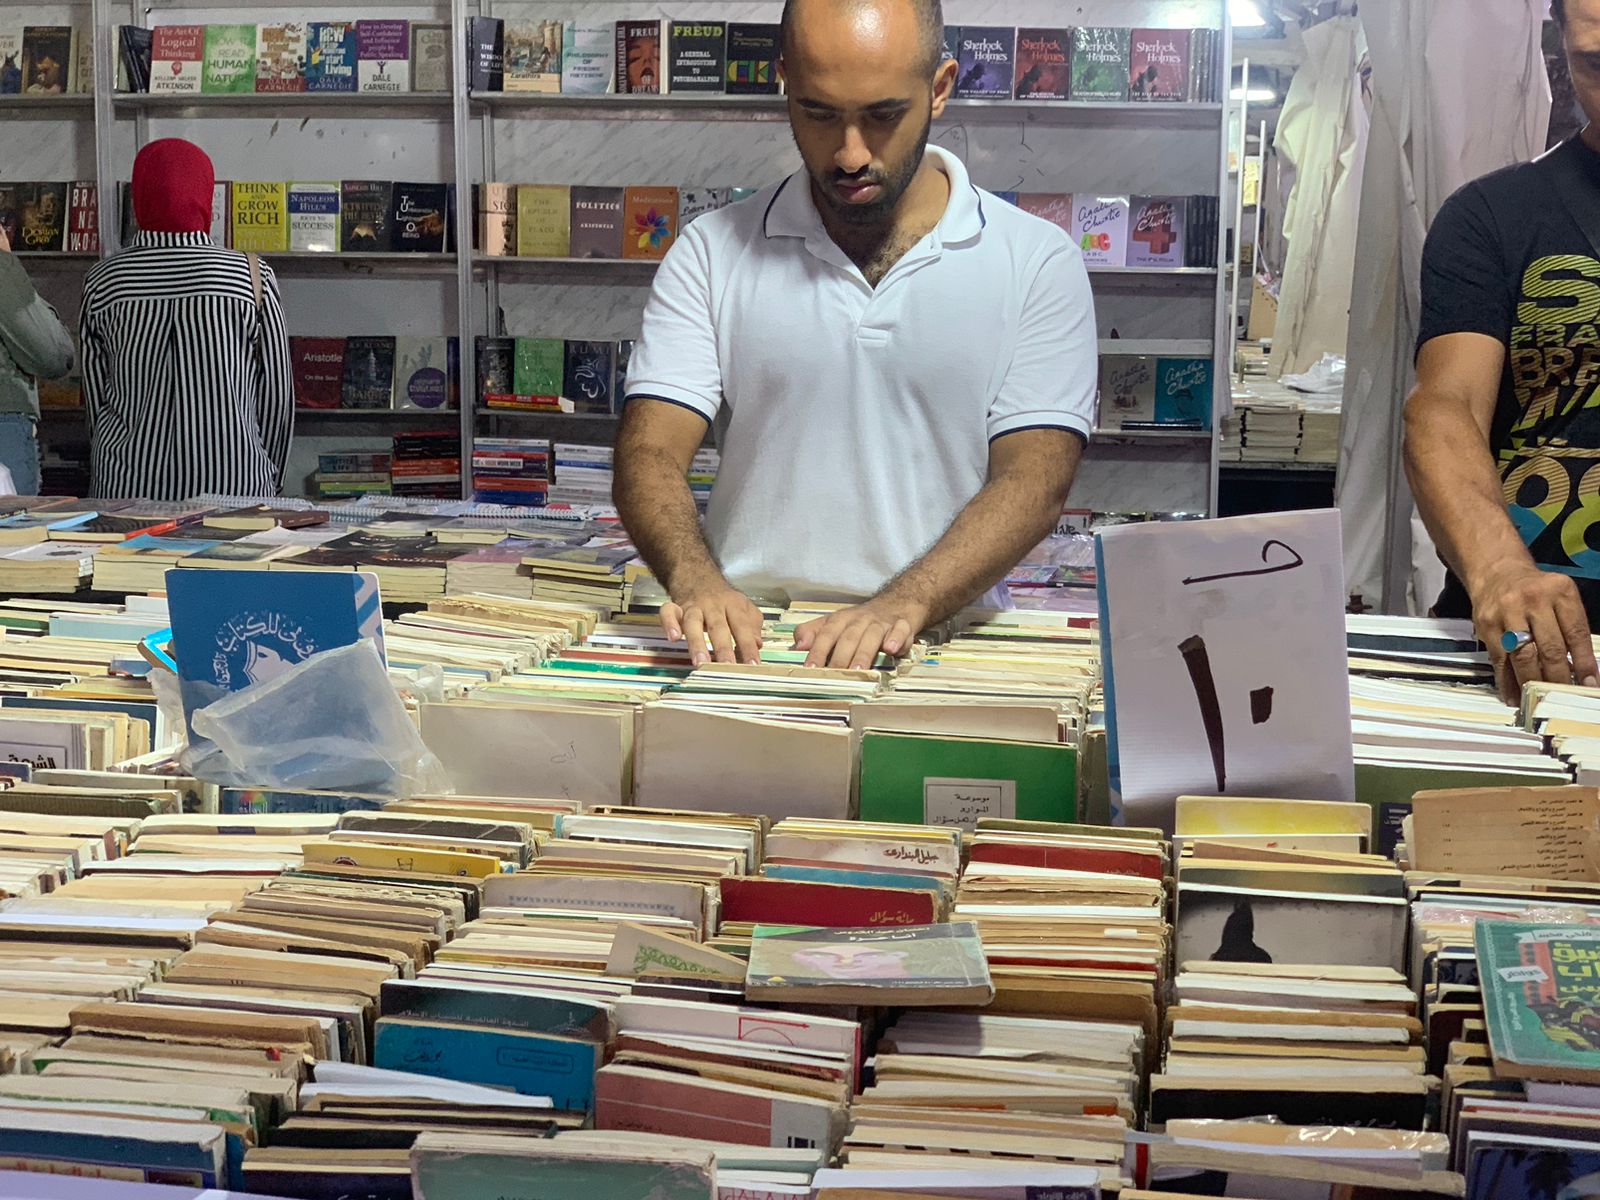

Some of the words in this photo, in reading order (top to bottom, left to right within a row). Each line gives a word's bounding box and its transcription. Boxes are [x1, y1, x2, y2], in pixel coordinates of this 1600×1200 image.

[159, 27, 174, 36] The
[174, 27, 187, 36] Art
[672, 25, 723, 37] FREUD
[160, 37, 197, 49] Logical
[480, 43, 494, 51] THE
[963, 38, 1004, 52] Sherlock
[1022, 37, 1061, 52] Sherlock
[1076, 39, 1119, 54] Sherlock
[1136, 40, 1177, 53] Sherlock
[160, 49, 196, 59] Thinking
[974, 50, 1009, 62] Holmes
[1032, 49, 1065, 63] Holmes
[1086, 51, 1122, 63] Holmes
[1147, 50, 1182, 64] Holmes
[207, 59, 251, 69] HUMAN
[325, 64, 353, 77] Living
[372, 73, 391, 82] DALE
[155, 82, 194, 90] ATKINSON
[362, 83, 401, 91] CARNEGIE
[236, 183, 280, 194] THINK
[72, 188, 97, 208] BRA
[291, 194, 336, 203] NAPOLEON
[237, 201, 279, 211] GROW
[575, 201, 620, 211] POLITICS
[1078, 202, 1116, 223] Agatha
[237, 212, 280, 225] RICH
[1136, 204, 1176, 222] Agatha
[78, 210, 95, 230] NE
[292, 220, 335, 231] SUCCESS
[1082, 207, 1122, 233] Christie
[1137, 212, 1177, 231] Christie
[303, 352, 343, 363] Aristotle
[1165, 360, 1205, 383] Agatha
[1167, 370, 1207, 396] Christie
[917, 849, 940, 865] جليل
[869, 910, 895, 924] سؤال
